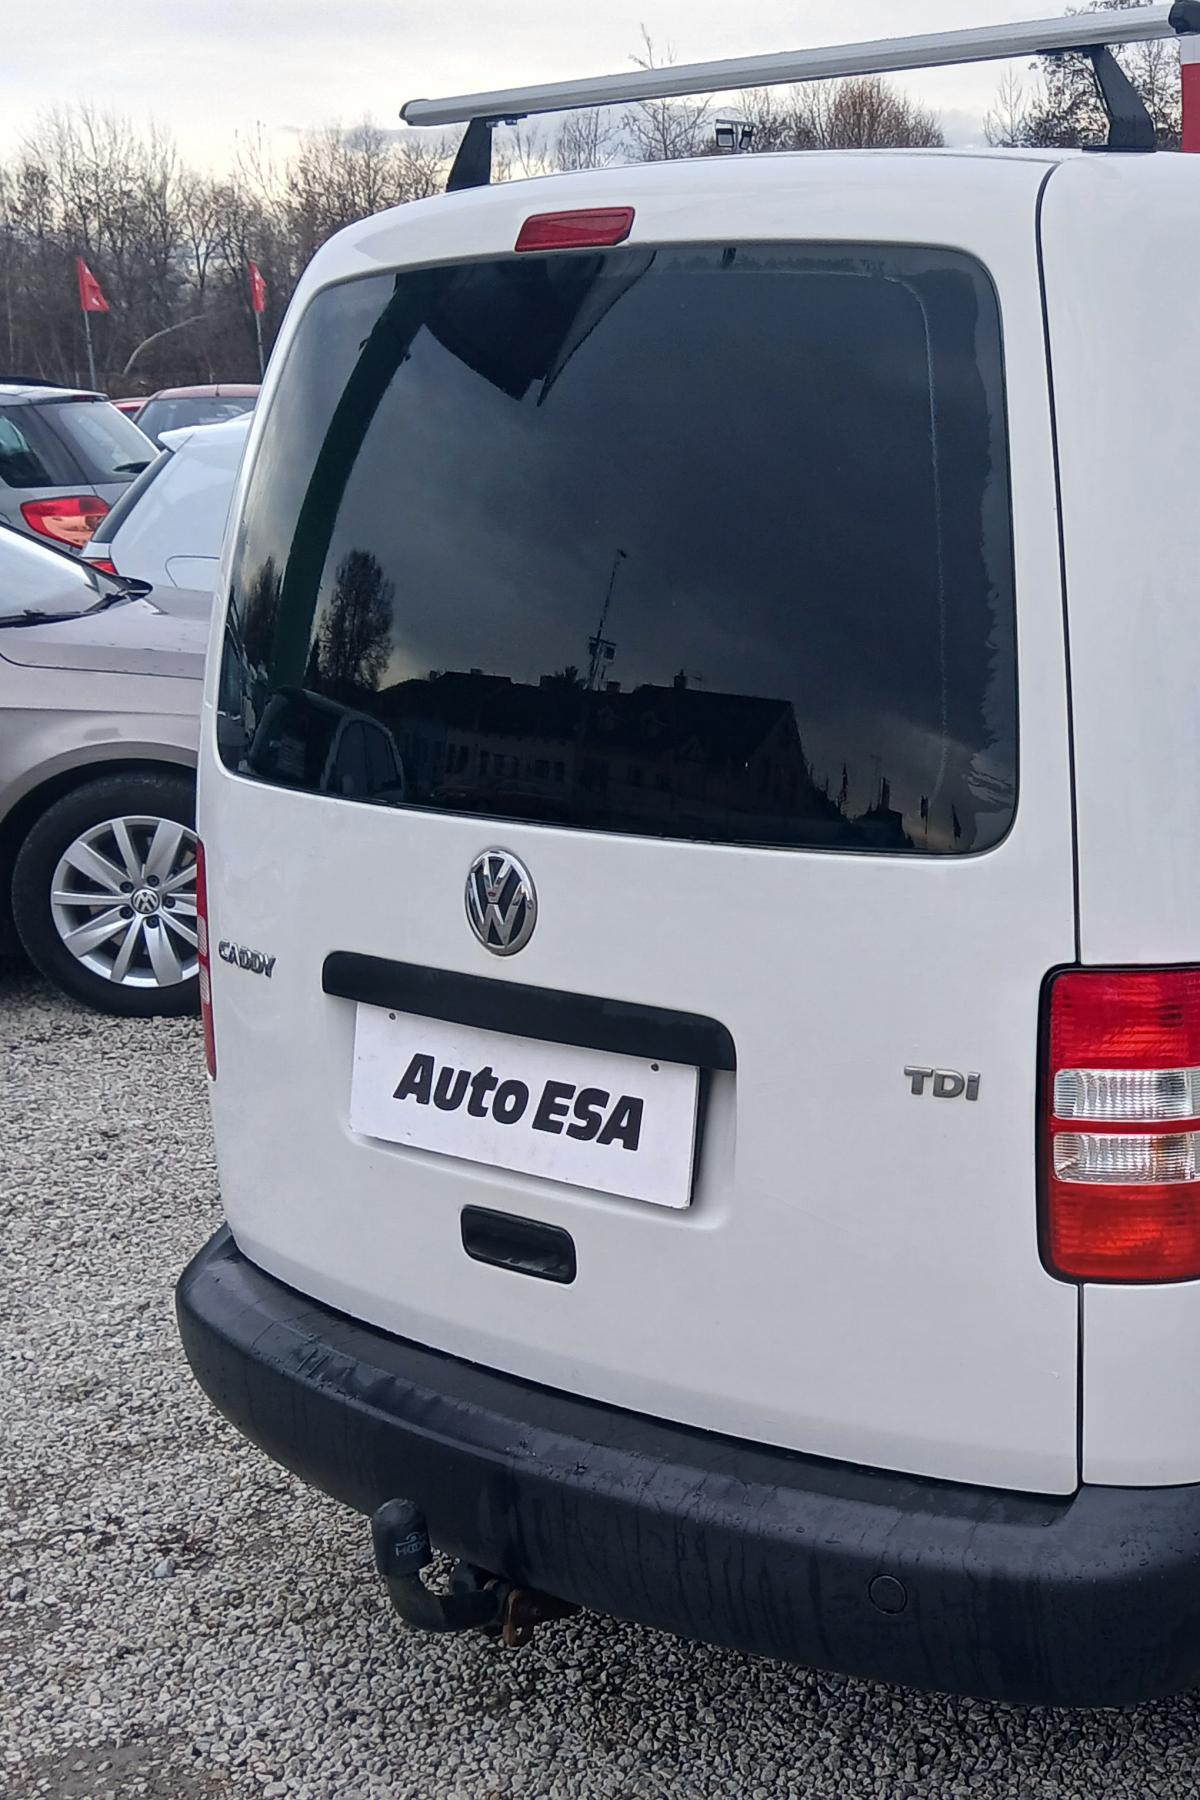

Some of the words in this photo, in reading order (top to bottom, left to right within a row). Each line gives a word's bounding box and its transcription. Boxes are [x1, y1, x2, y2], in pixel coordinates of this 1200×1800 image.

[218, 940, 277, 978] CADDY
[392, 1052, 530, 1125] Auto
[531, 1079, 644, 1152] ESA
